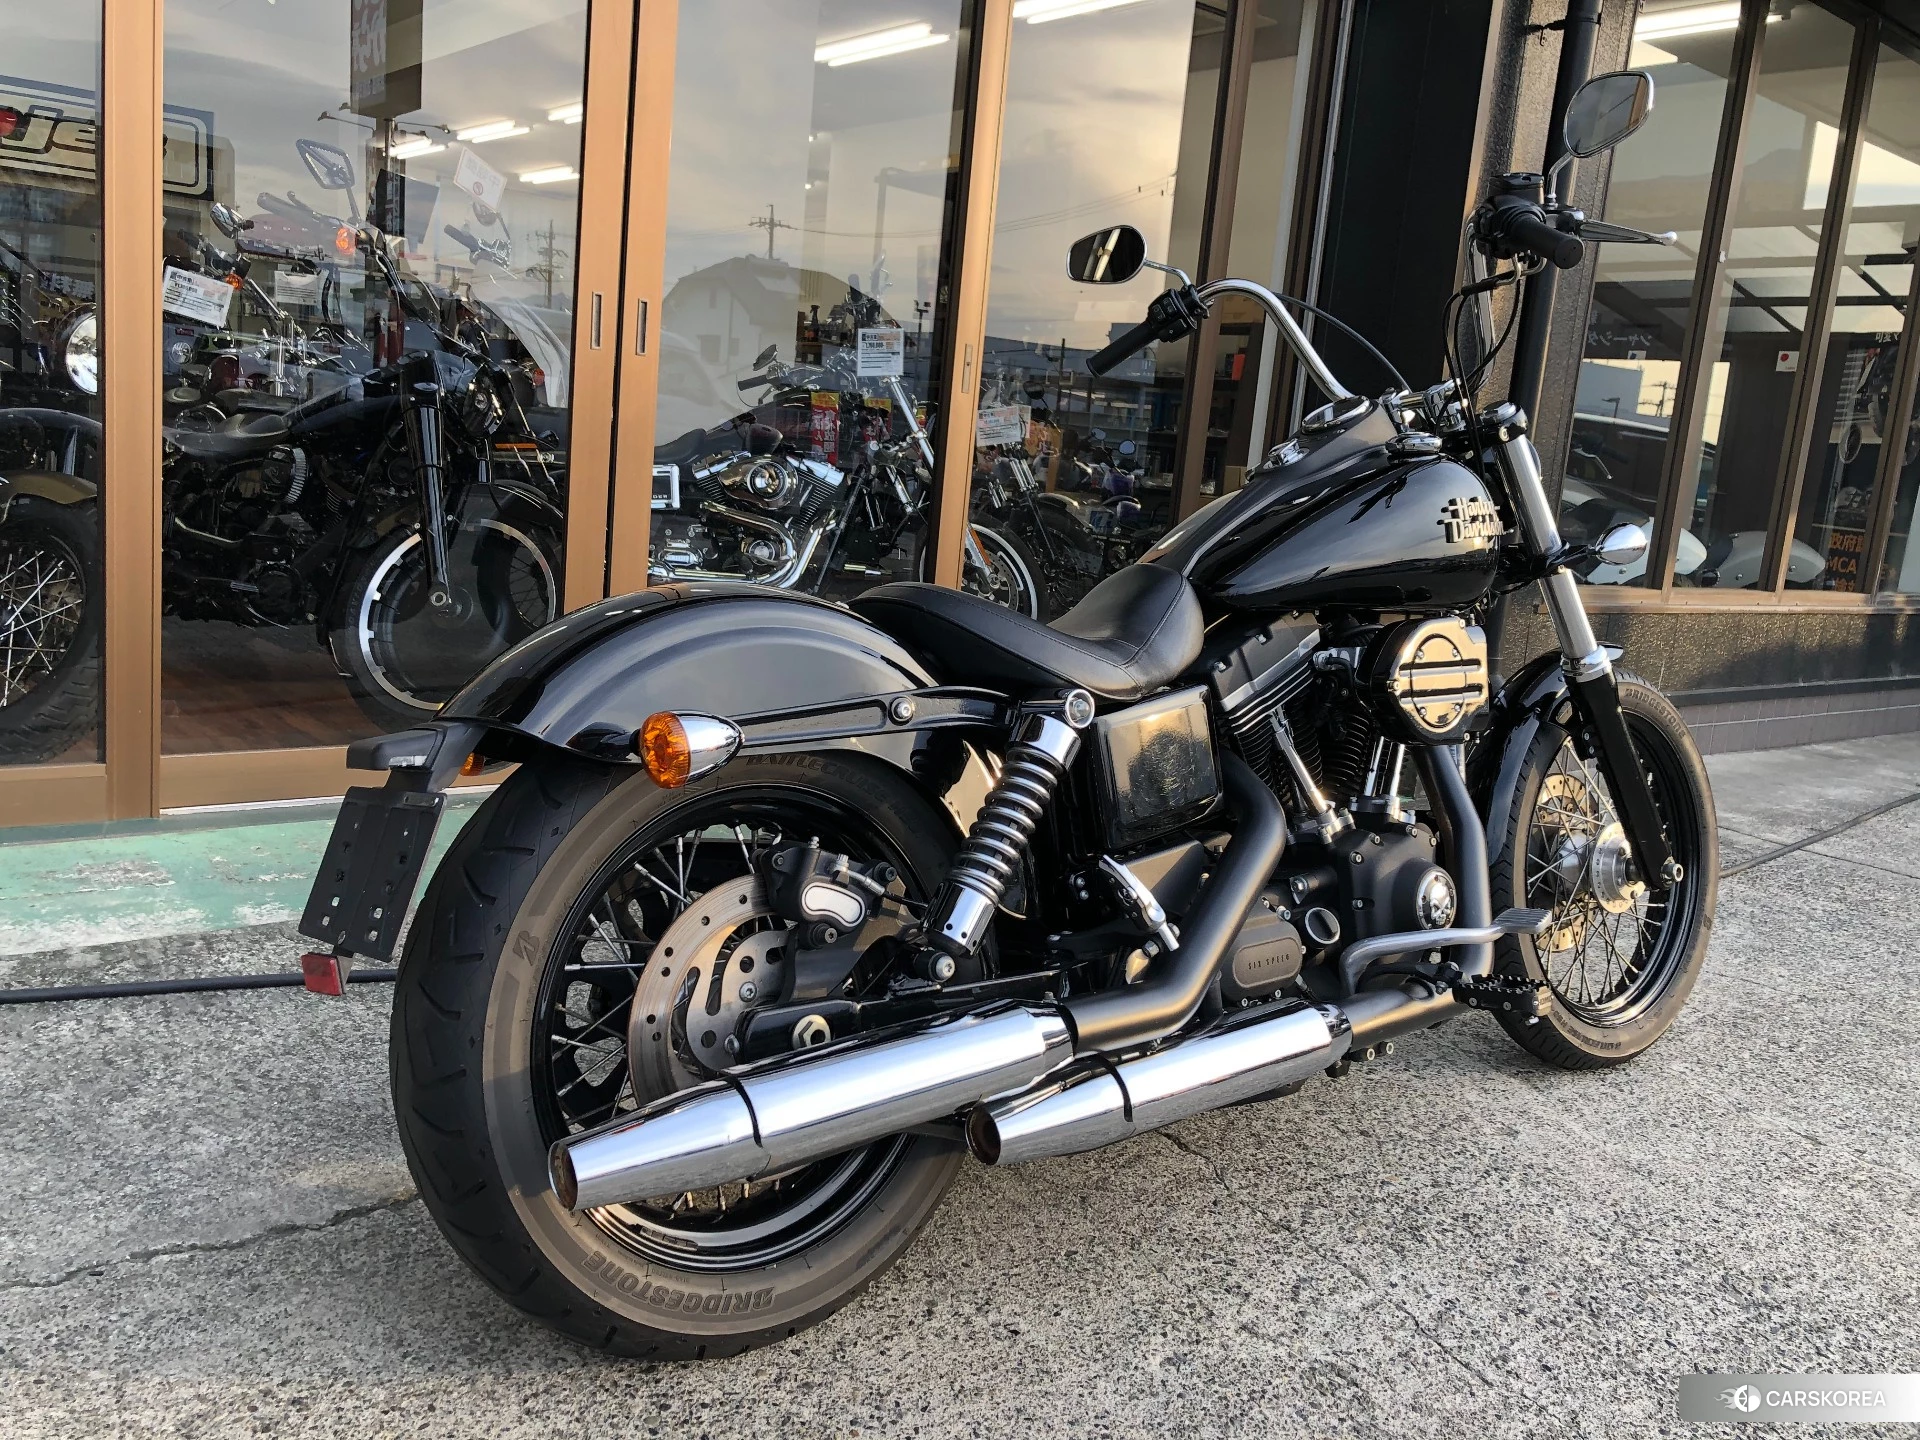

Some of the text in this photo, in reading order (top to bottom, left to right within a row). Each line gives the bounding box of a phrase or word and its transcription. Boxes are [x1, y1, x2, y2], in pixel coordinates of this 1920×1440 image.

[1625, 688, 1686, 739] BRIDGESTONE
[1248, 961, 1261, 970] SIX
[581, 1250, 775, 1316] BRIDGESTONE
